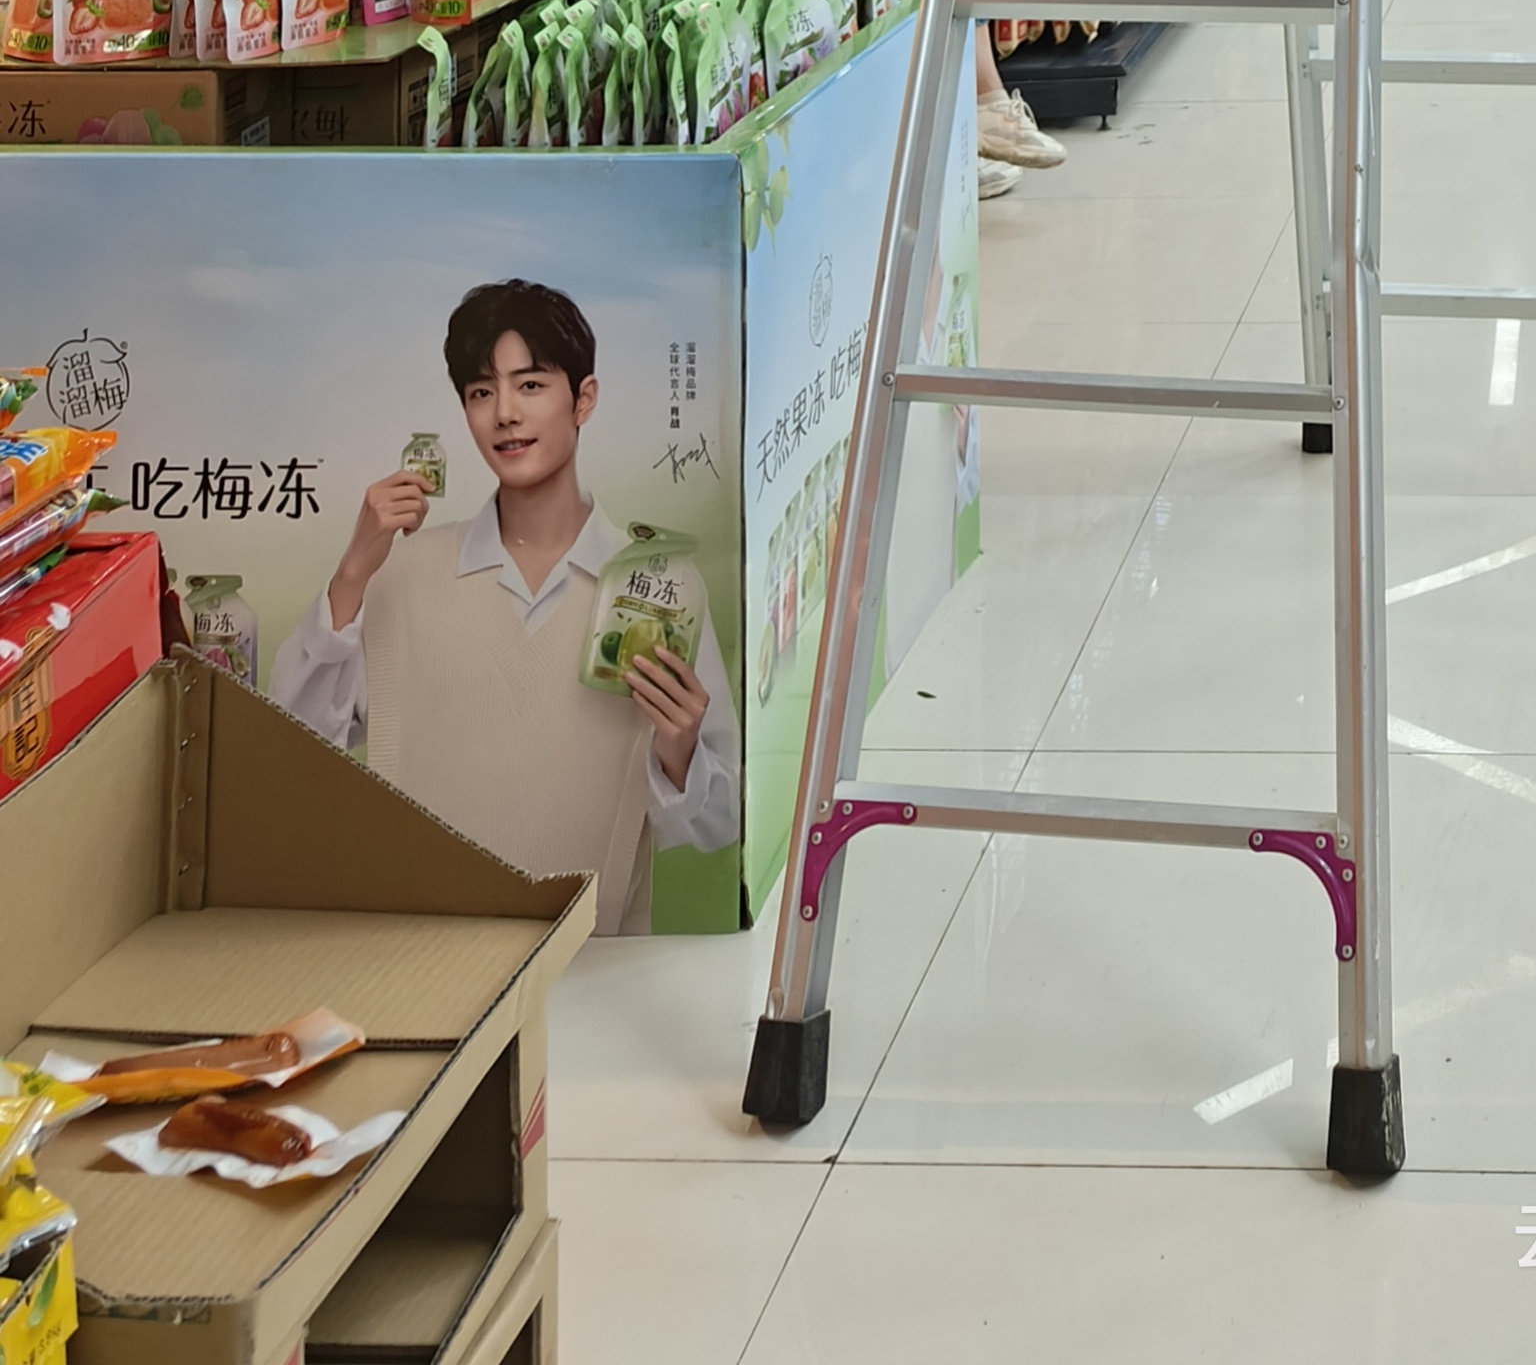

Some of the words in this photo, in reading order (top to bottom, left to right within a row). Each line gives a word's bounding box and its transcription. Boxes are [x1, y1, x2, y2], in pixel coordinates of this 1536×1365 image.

[669, 341, 681, 402] 全球代言人
[685, 341, 697, 401] 溜溜梅品牌
[669, 405, 681, 430] 肖战
[755, 370, 826, 503] 天然果冻
[131, 457, 321, 520] 吃梅冻
[626, 570, 681, 606] 梅冻
